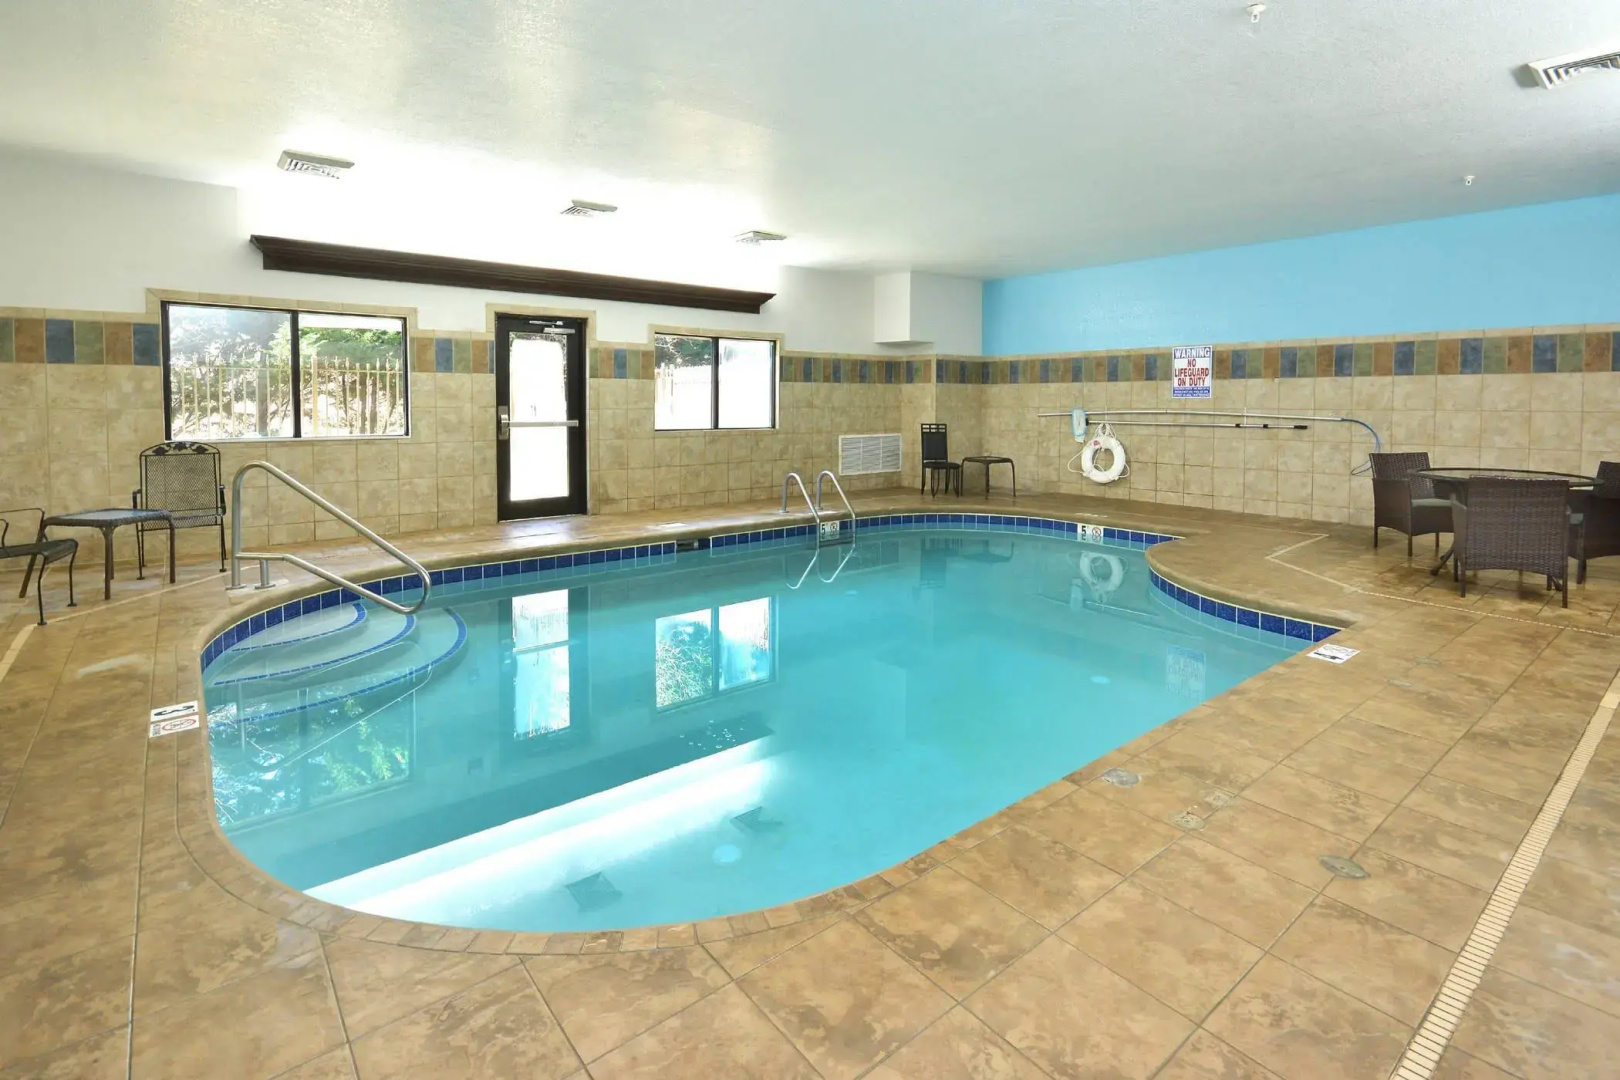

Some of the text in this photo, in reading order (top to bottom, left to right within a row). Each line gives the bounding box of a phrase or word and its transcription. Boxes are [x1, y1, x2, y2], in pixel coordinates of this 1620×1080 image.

[1174, 348, 1210, 359] WARNING
[1187, 359, 1196, 367] NO
[1174, 368, 1209, 377] LIFEGUARD
[1178, 377, 1205, 386] ON DUTY
